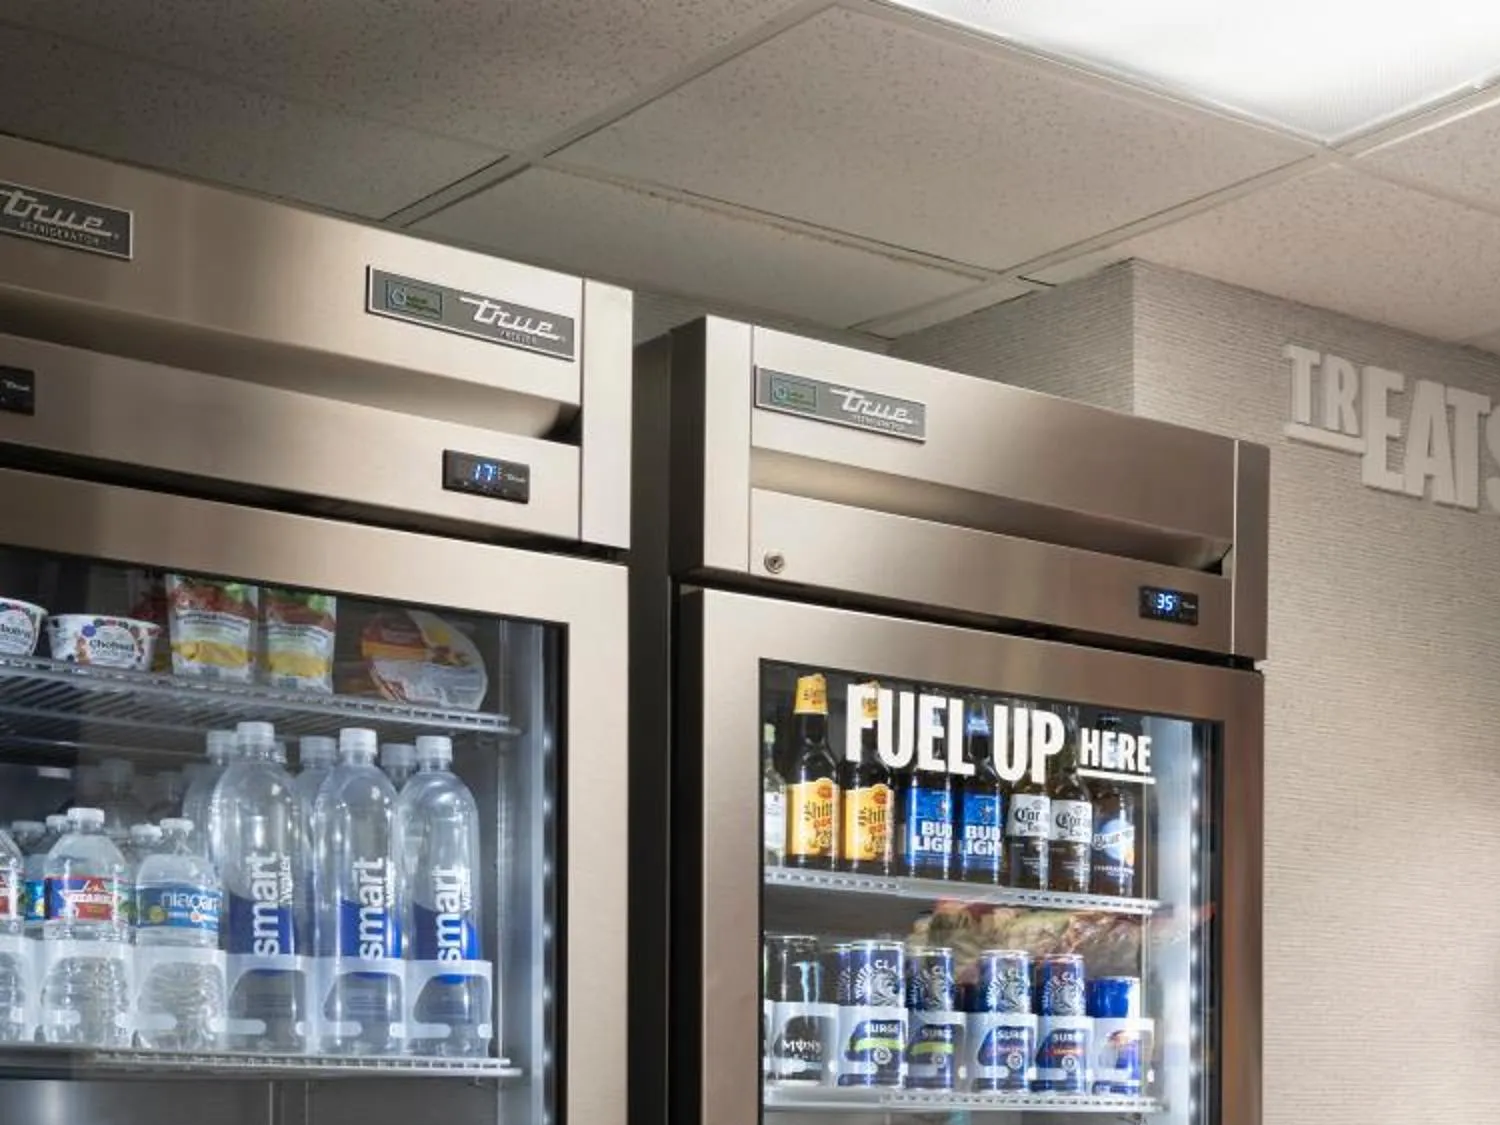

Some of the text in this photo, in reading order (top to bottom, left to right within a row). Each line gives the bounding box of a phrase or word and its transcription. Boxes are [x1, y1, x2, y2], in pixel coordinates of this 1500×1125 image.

[458, 297, 558, 341] true
[830, 387, 914, 425] true
[1157, 593, 1173, 611] 35
[845, 683, 1152, 785] FUEL UP HERE
[246, 851, 280, 958] smart
[353, 857, 386, 962] smart
[433, 864, 464, 963] smart
